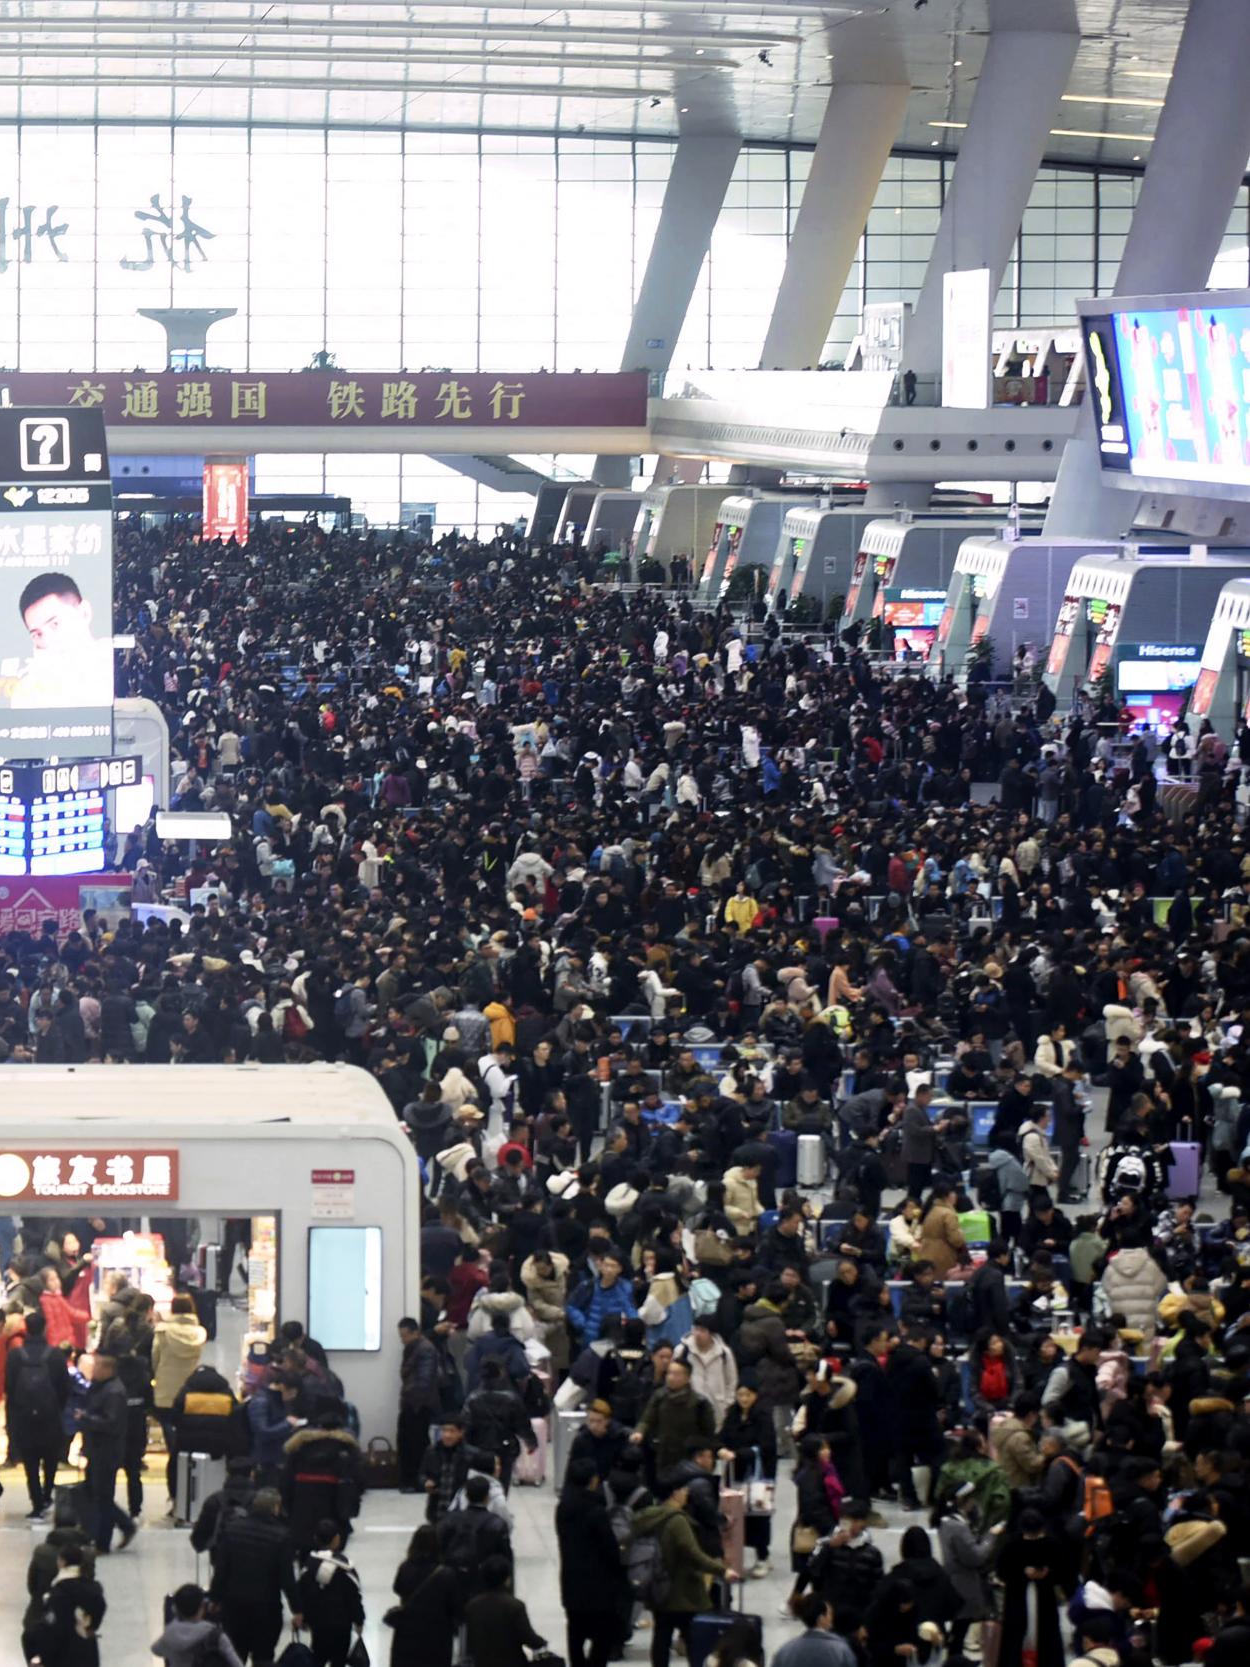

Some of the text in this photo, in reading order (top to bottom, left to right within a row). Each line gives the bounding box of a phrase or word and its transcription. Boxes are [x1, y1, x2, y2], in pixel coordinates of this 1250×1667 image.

[66, 379, 268, 420] 交通强国
[326, 380, 527, 420] 铁路先行
[1138, 644, 1197, 657] Hisense
[34, 1184, 170, 1196] TOURIST BOOKSTORE
